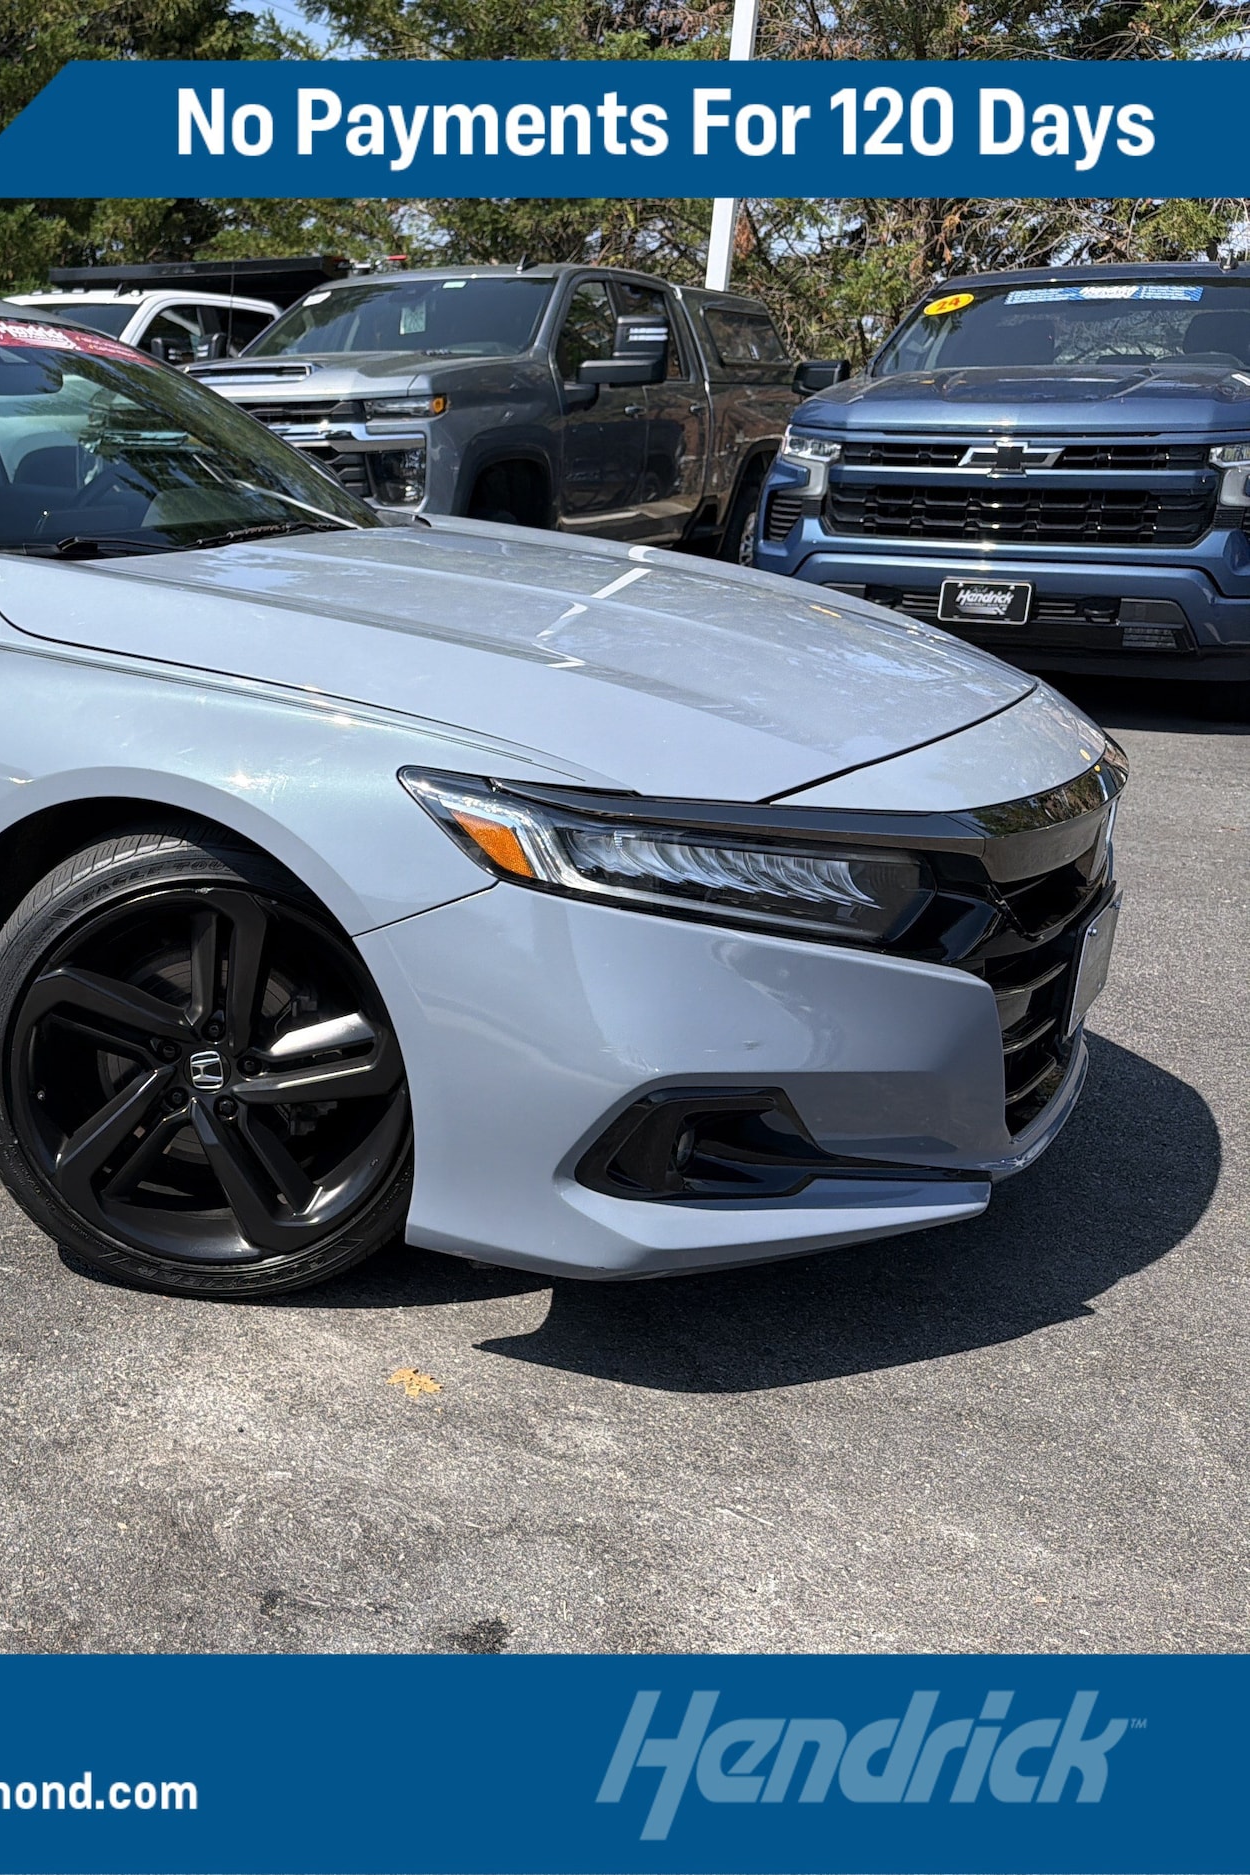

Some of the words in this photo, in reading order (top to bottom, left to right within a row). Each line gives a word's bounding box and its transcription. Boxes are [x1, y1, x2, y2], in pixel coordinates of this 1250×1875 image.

[936, 297, 960, 312] 24
[955, 589, 1015, 606] Hendrick
[83, 864, 162, 904] EAGLE
